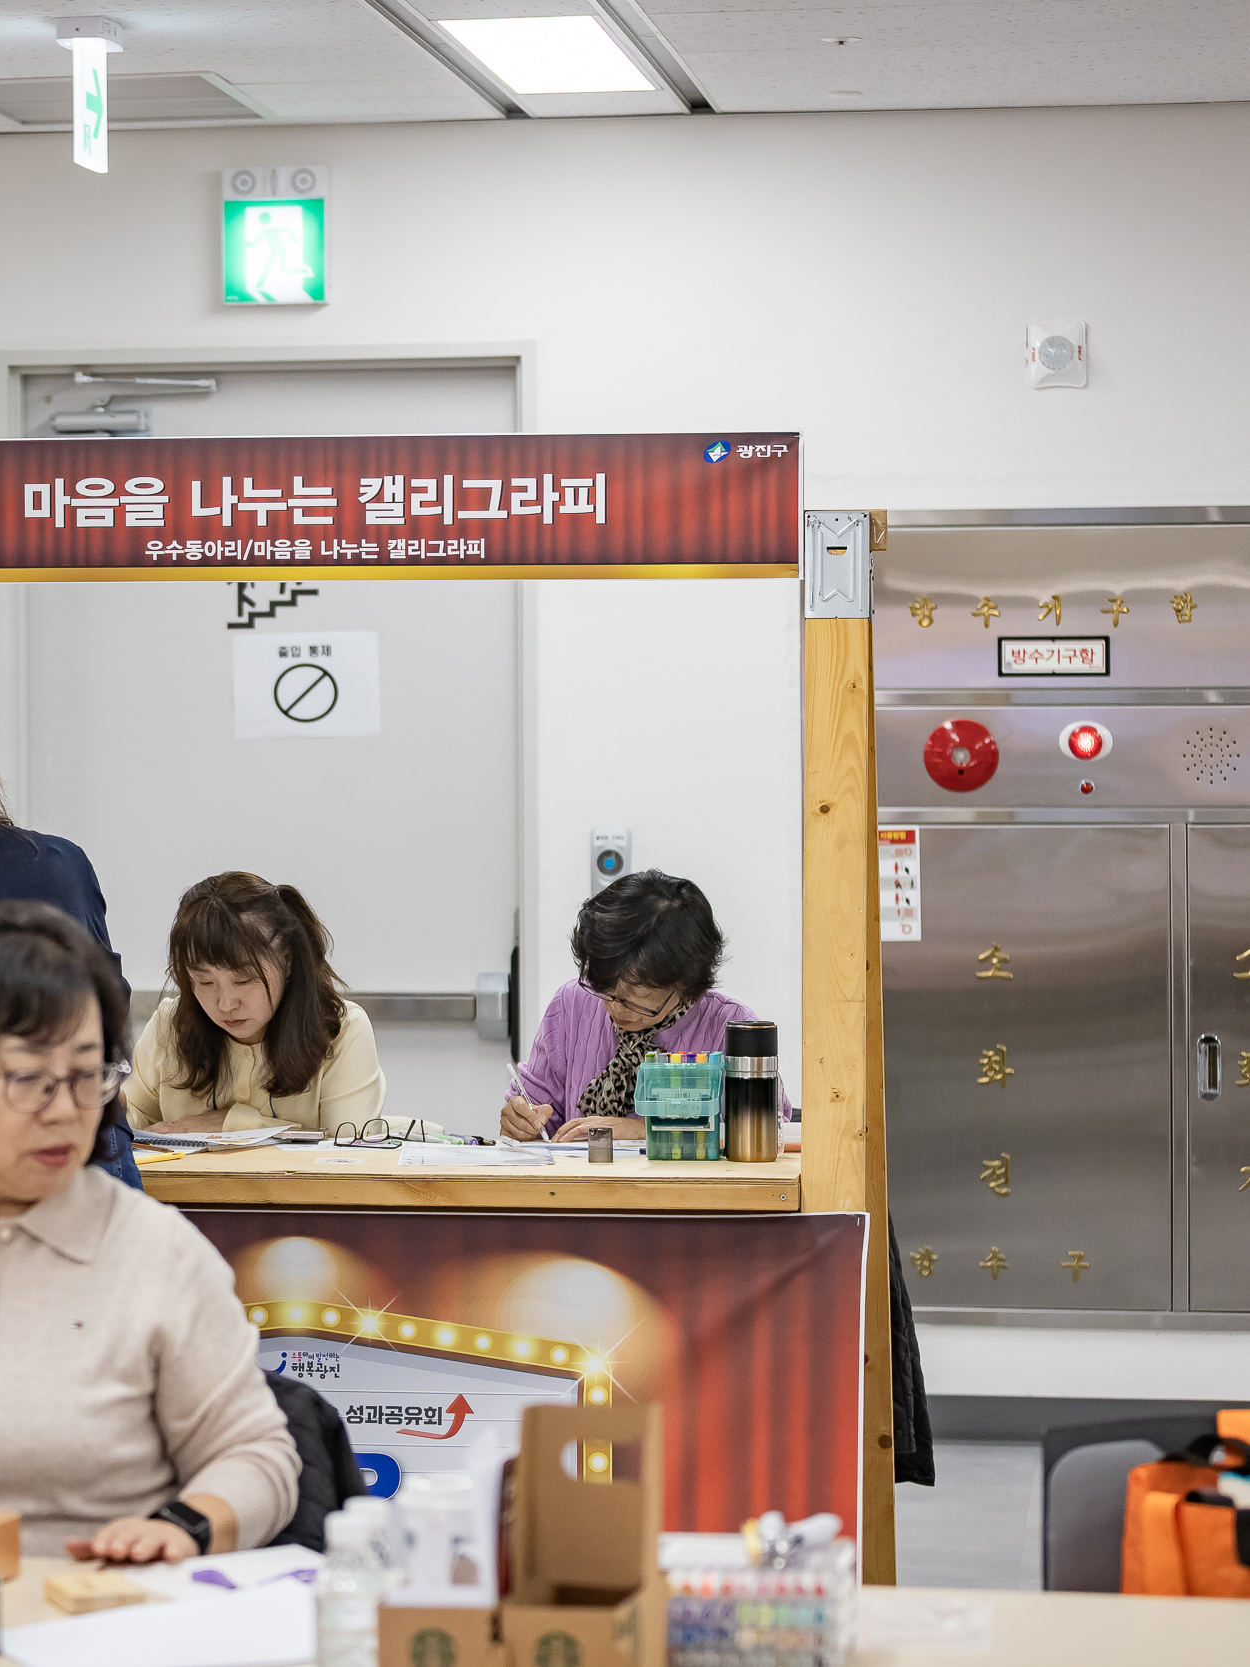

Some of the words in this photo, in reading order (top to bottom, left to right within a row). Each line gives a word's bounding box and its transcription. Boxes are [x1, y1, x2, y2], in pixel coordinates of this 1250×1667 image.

[735, 442, 790, 459] 광진구
[23, 478, 170, 529] 마음을
[190, 476, 339, 528] 나누는
[356, 472, 608, 526] 캘리그라피
[144, 538, 313, 562] 우수동아리/마음을
[321, 537, 380, 561] 나누는
[386, 537, 486, 560] 캘리그라피
[1011, 646, 1097, 666] 방수기구함
[291, 1361, 340, 1379] 행복광진
[345, 1404, 443, 1426] 성과공유회
